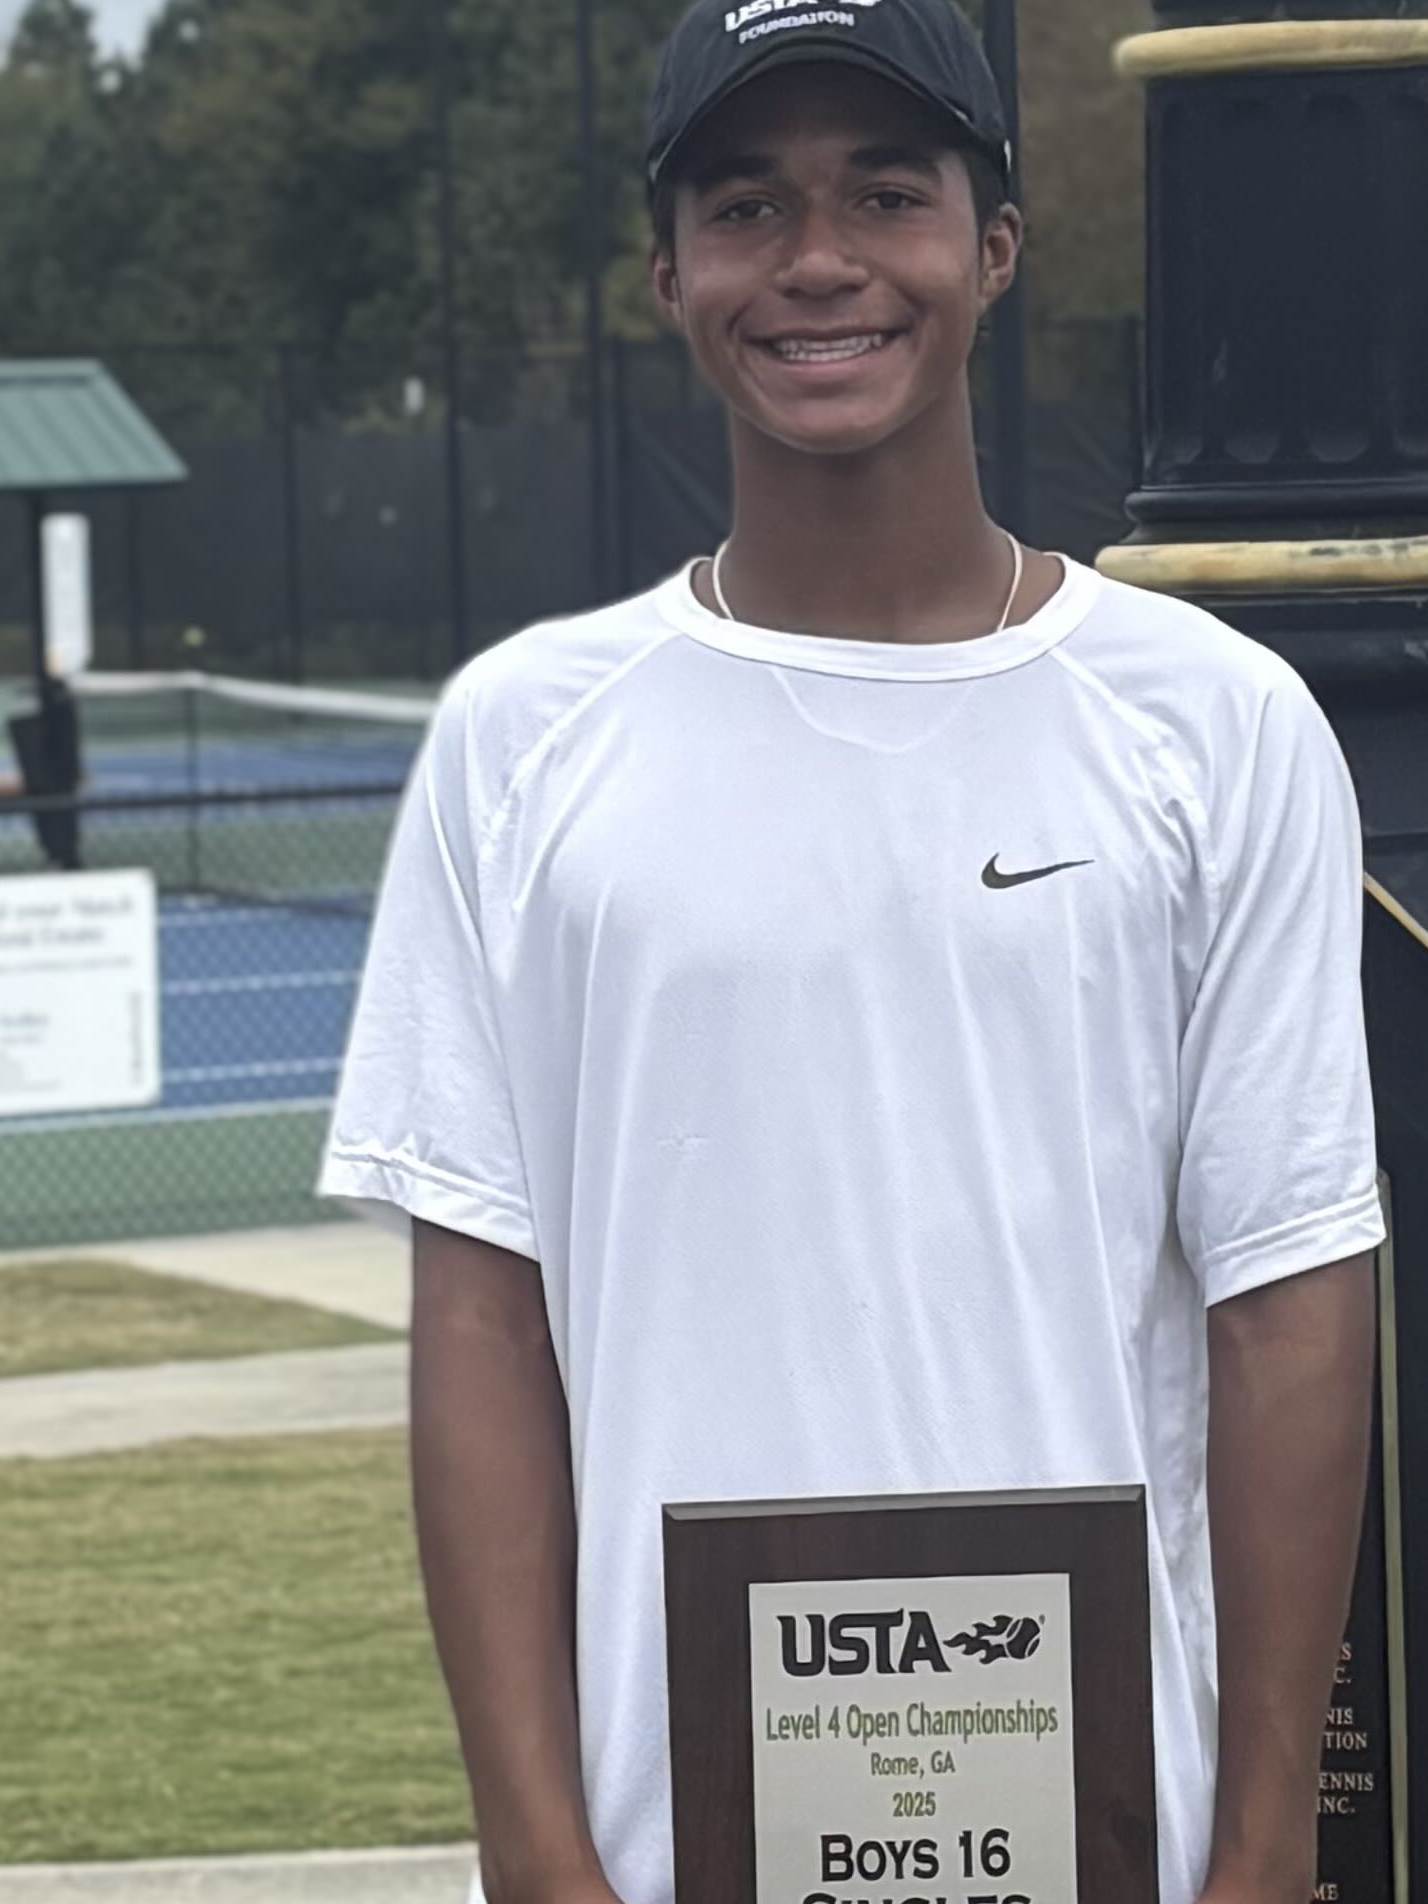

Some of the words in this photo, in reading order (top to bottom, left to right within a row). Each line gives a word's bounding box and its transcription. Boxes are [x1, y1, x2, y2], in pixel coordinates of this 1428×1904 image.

[738, 10, 855, 45] FOUNDATION
[776, 1607, 953, 1677] USTA
[766, 1705, 821, 1741] Level
[827, 1706, 841, 1739] 4
[846, 1703, 900, 1747] Open
[907, 1698, 1059, 1745] Championships
[870, 1751, 925, 1780] Rome,
[930, 1749, 956, 1774] GA
[1318, 1771, 1375, 1793] ENNIS
[892, 1791, 937, 1818] 2025
[958, 1828, 1012, 1879] 16
